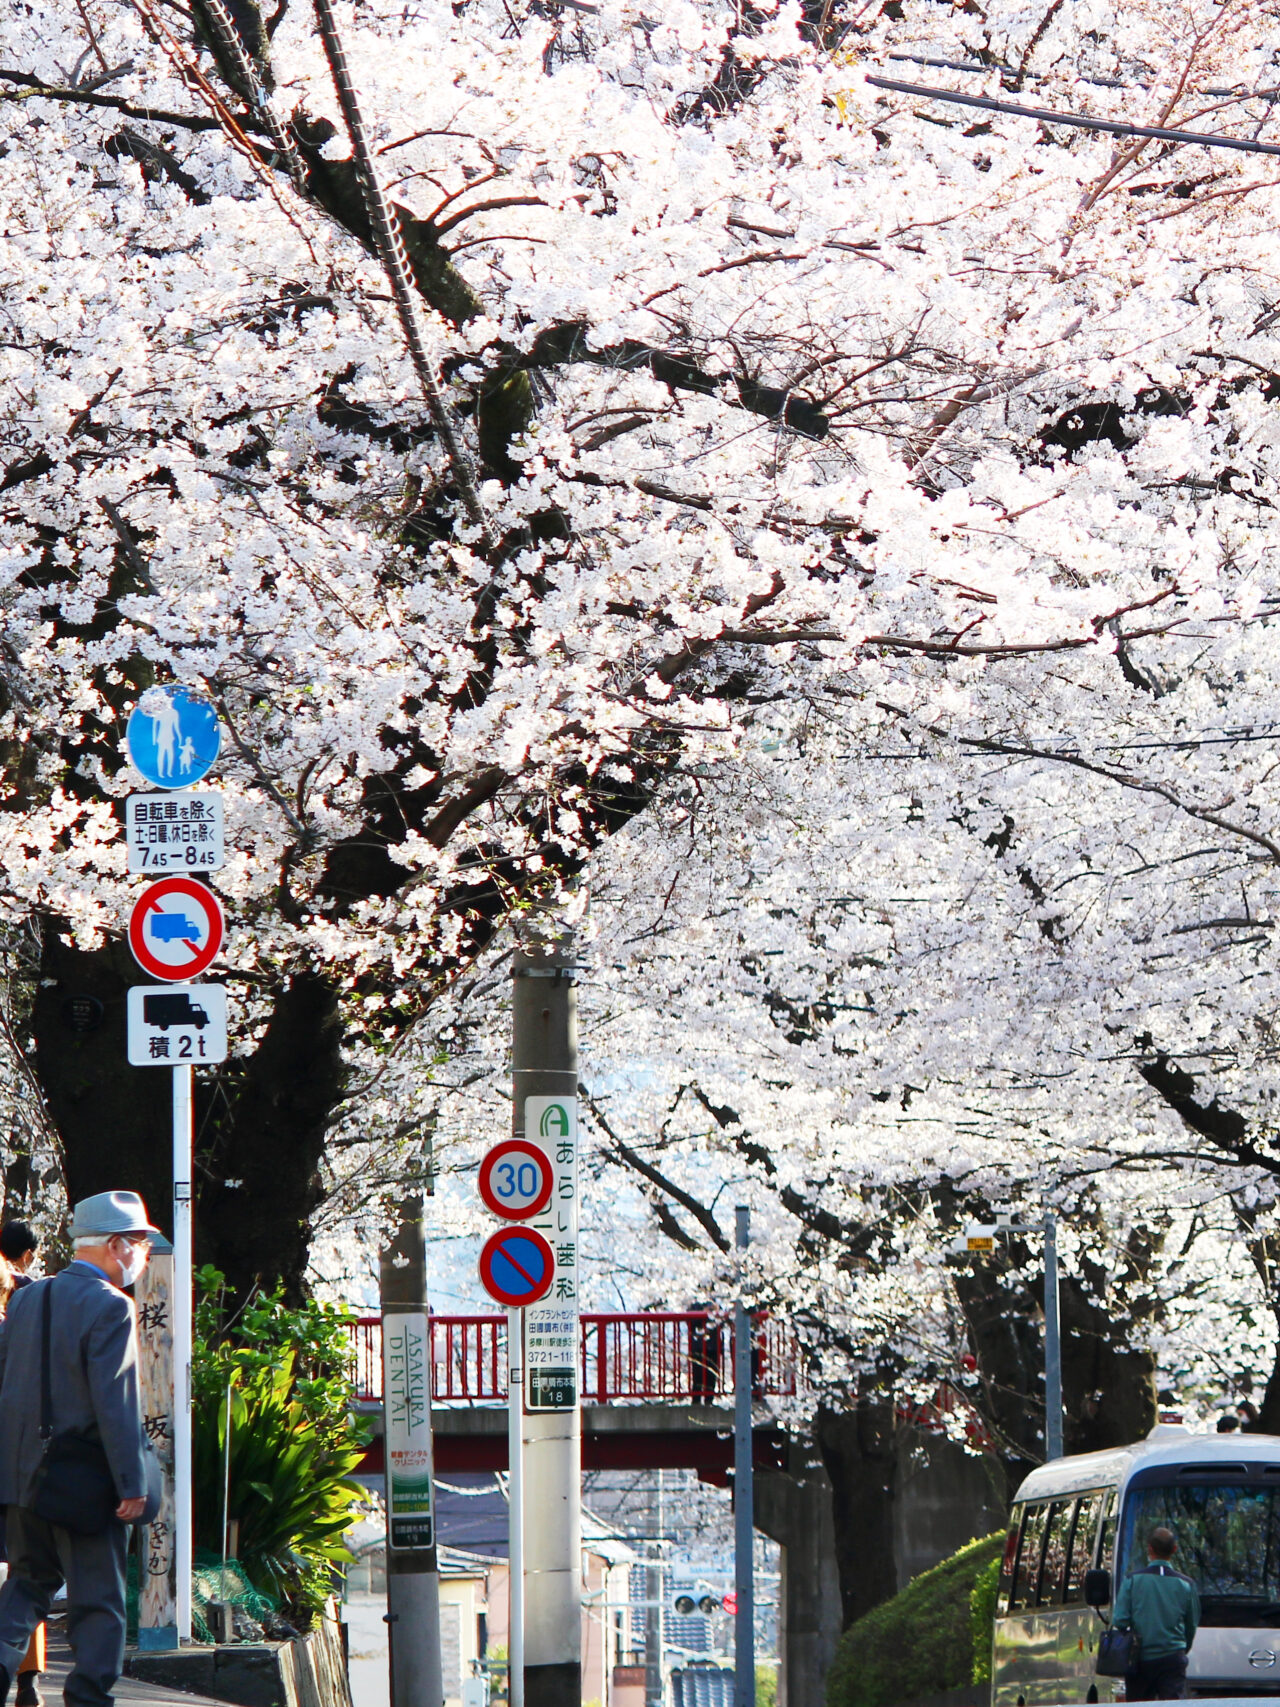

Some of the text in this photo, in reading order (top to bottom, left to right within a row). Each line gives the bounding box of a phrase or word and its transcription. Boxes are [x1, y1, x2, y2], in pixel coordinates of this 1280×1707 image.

[134, 800, 215, 821] 自転車を除く
[497, 1162, 537, 1198] 30
[556, 1141, 576, 1302] あらし歯科
[389, 1336, 406, 1426] DENTAL
[409, 1333, 425, 1428] ASAKURA
[549, 1391, 563, 1402] 18
